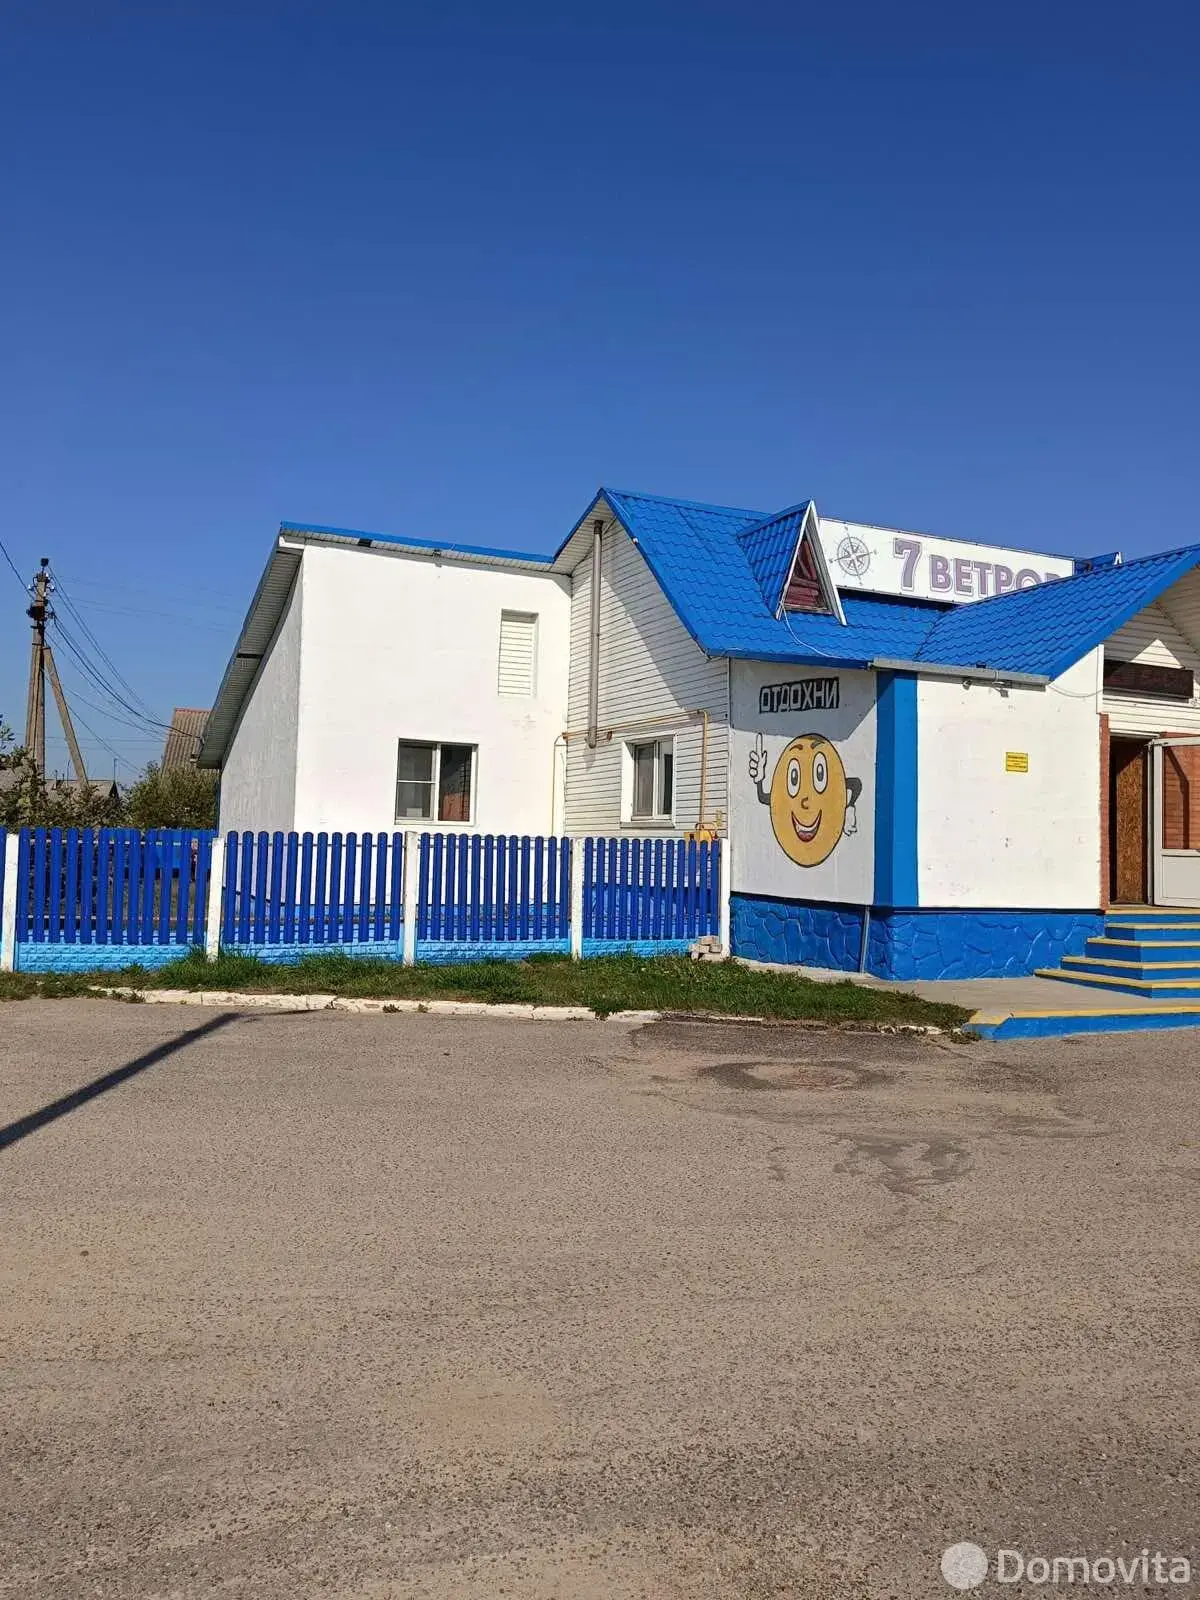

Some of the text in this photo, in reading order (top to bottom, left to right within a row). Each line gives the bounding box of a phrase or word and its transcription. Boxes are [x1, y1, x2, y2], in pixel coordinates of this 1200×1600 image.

[893, 537, 1062, 597] 7 ВЕТРО
[760, 679, 839, 713] ОТДОХНИ
